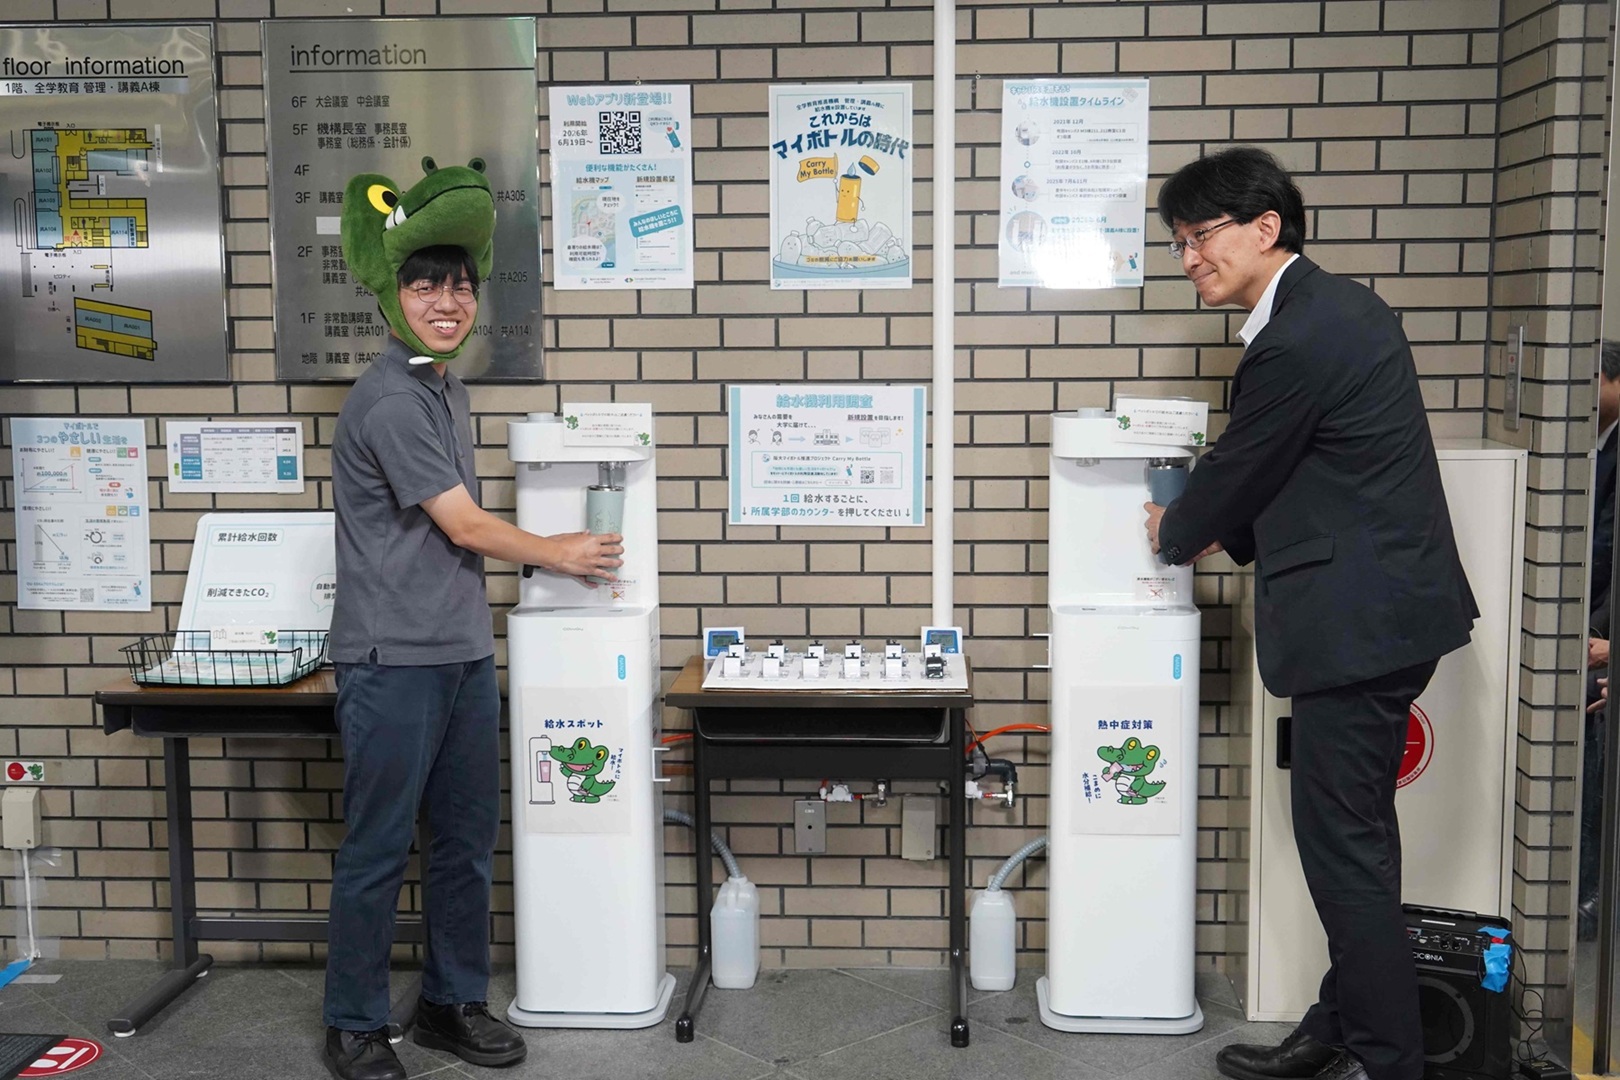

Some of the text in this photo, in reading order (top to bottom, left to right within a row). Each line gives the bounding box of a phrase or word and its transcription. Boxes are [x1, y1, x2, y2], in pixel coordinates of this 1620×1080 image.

[291, 44, 427, 66] information
[3, 57, 184, 75] floor information
[6, 81, 161, 94] 1階、全学教育 管理・講義A棟
[291, 95, 390, 108] 6F 大会議室 中会議室
[1029, 96, 1125, 107] 給水機設置タイムライン
[809, 111, 873, 129] これからは
[292, 122, 407, 136] 5F 機構長室 事務長室
[562, 129, 589, 137] 2026年
[772, 128, 910, 160] マイボトルの時代
[294, 164, 310, 176] 4F
[806, 160, 827, 169] Carry
[800, 167, 835, 178] My Bottle
[575, 176, 610, 184] 給水機マップ
[636, 175, 676, 183] 新規設置希望
[295, 192, 311, 204] 3F
[497, 189, 526, 202] 共A305
[297, 246, 313, 258] 2F
[300, 311, 373, 324] 1F 非常勤講師室
[302, 352, 318, 365] 地階
[776, 393, 874, 409] 給水機利用調査
[783, 493, 800, 503] 1回
[751, 506, 902, 517] 所属学部のカウンター を押してください
[218, 532, 278, 542] 累計給水回数
[544, 719, 604, 729] 給水スポット
[1098, 719, 1153, 730] 熱中症対策
